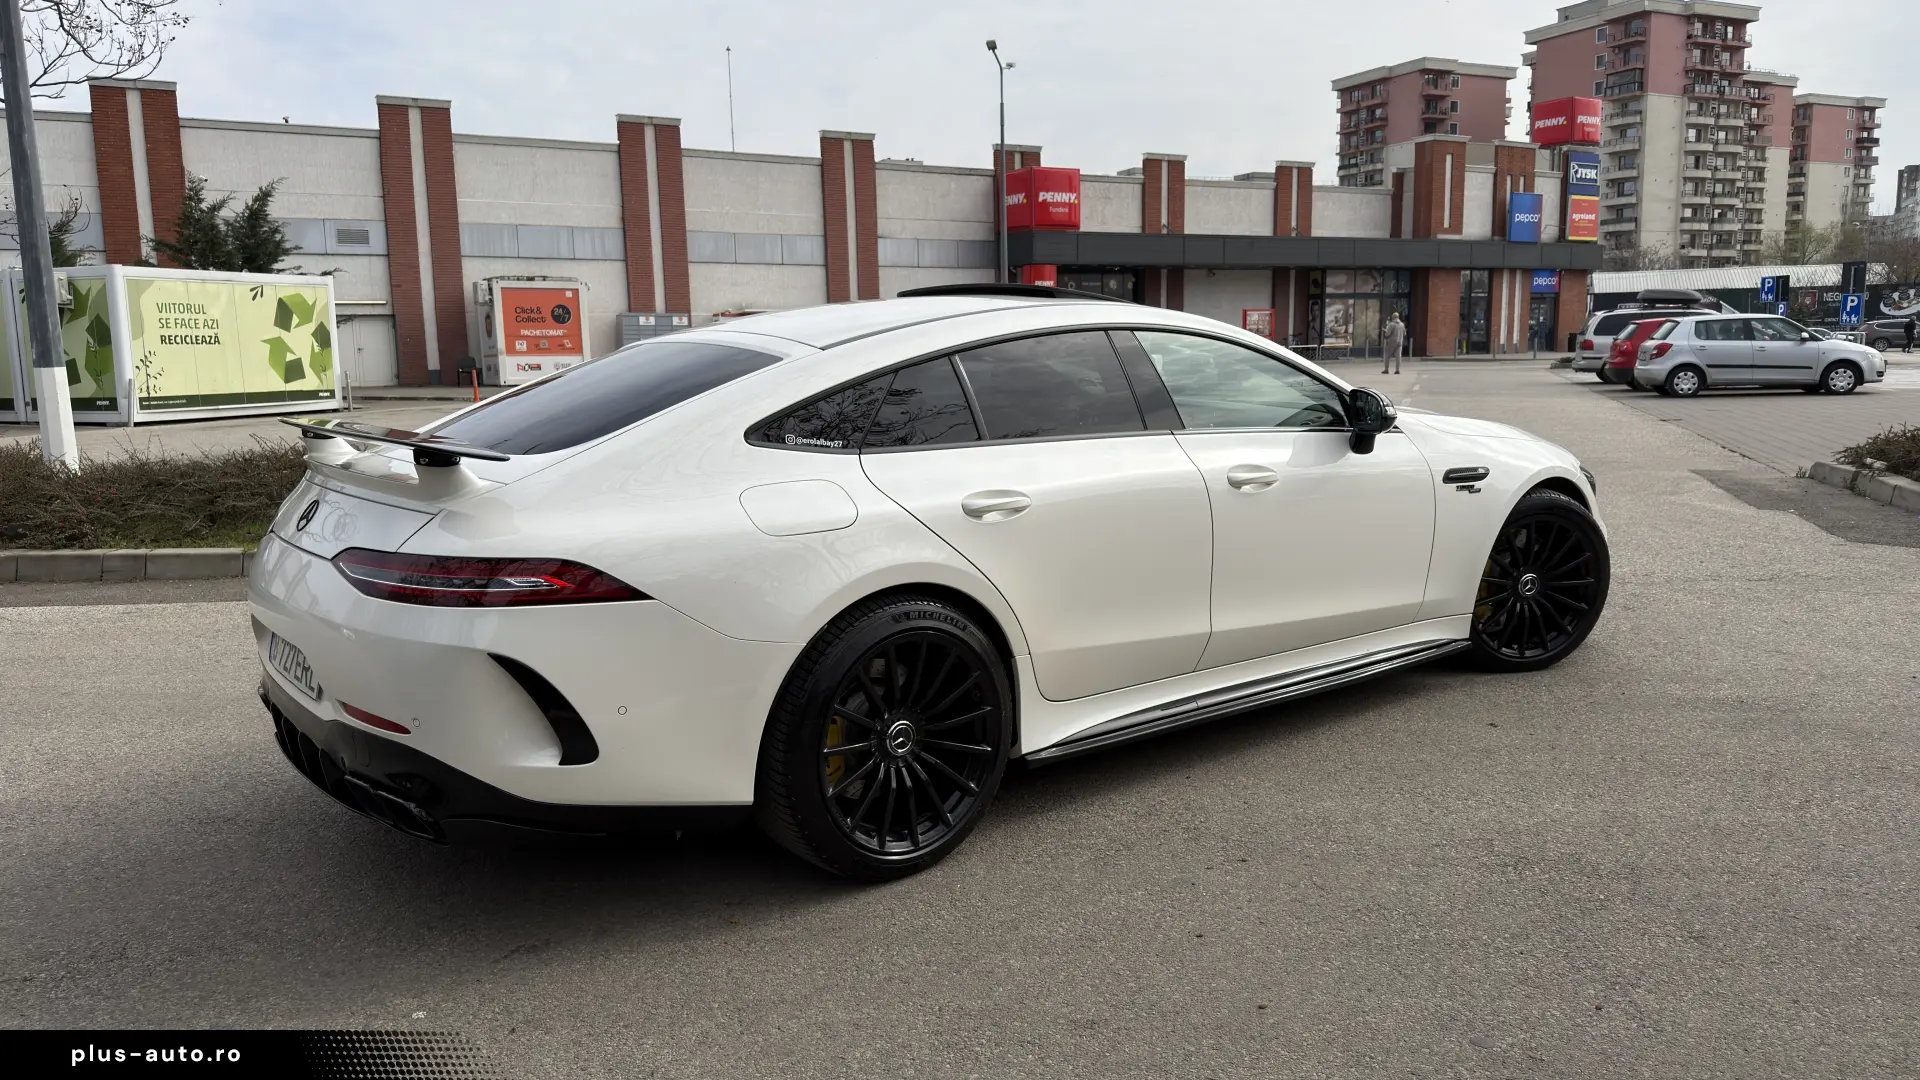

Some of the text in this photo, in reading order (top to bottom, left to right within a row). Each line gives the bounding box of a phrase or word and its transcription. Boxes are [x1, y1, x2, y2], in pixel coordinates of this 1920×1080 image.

[1535, 116, 1567, 128] PENNY.
[1576, 169, 1597, 179] JYSK
[1039, 192, 1078, 203] PENNY.
[1514, 212, 1539, 222] pepco
[1572, 212, 1596, 222] agroland
[1533, 275, 1557, 286] pepco
[1764, 278, 1773, 292] P
[156, 302, 207, 315] VIITORUL
[1778, 303, 1785, 316] P
[1847, 296, 1858, 311] P
[158, 317, 219, 330] SE FACE AZI
[160, 332, 221, 345] RECICLEAZĂ
[520, 329, 564, 337] PACHETOMAT
[909, 611, 967, 631] MICHELIN
